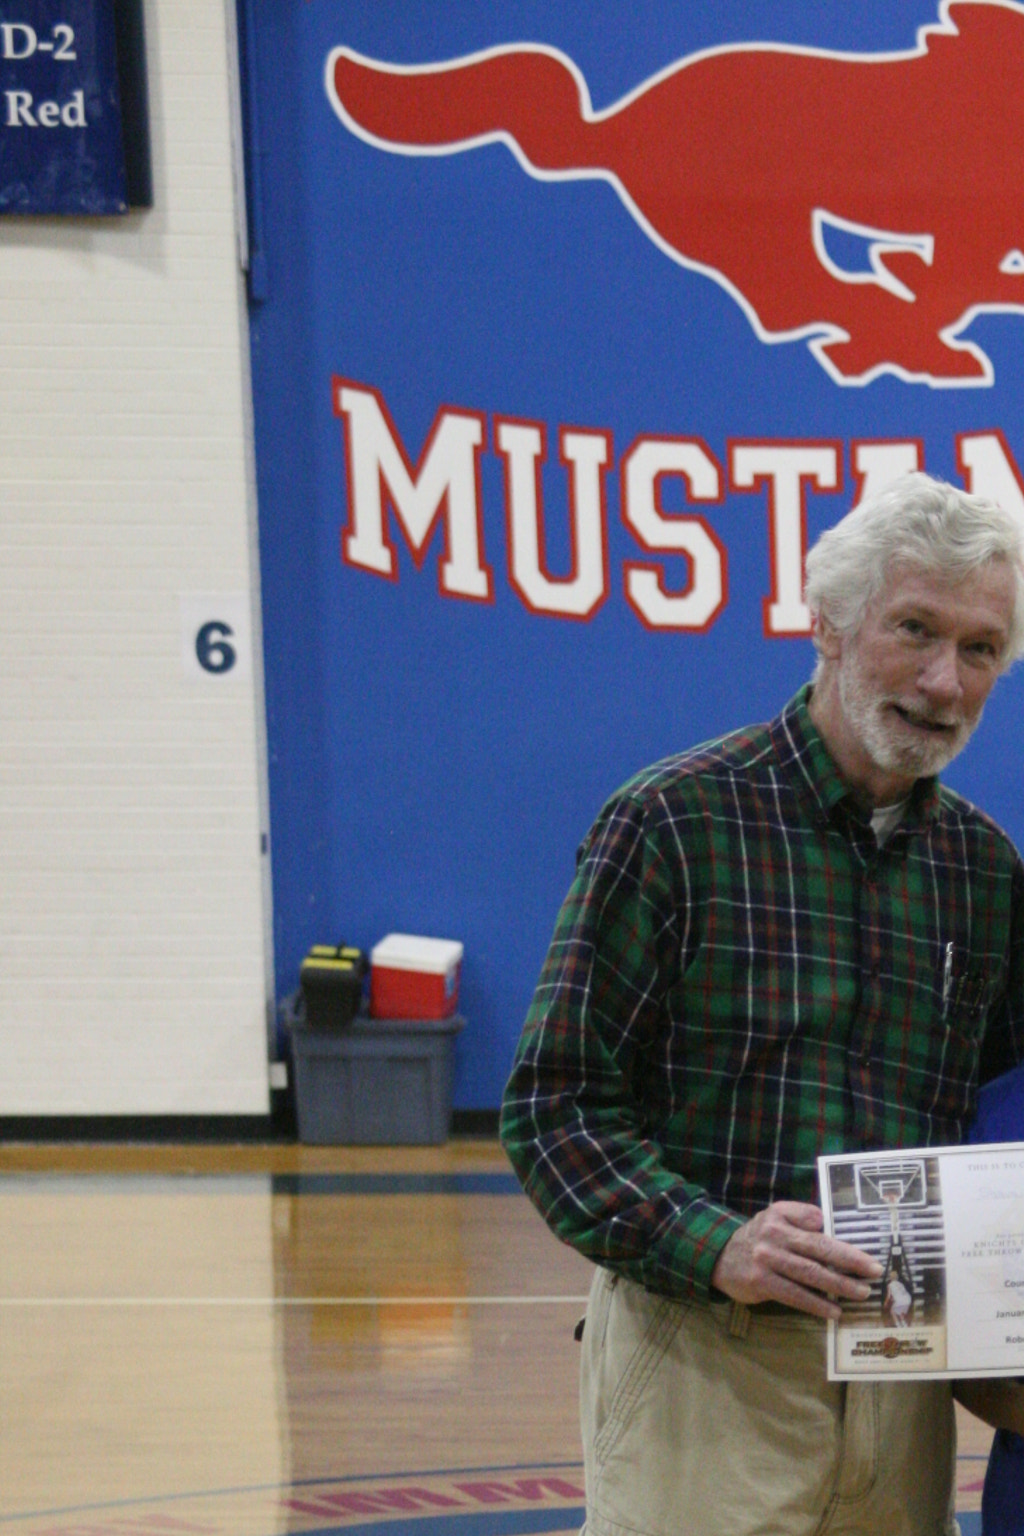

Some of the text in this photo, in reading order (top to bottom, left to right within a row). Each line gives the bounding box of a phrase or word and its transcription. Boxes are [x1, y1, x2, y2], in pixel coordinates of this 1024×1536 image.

[0, 23, 77, 61] D-2
[4, 89, 88, 127] Red
[195, 620, 237, 674] 6
